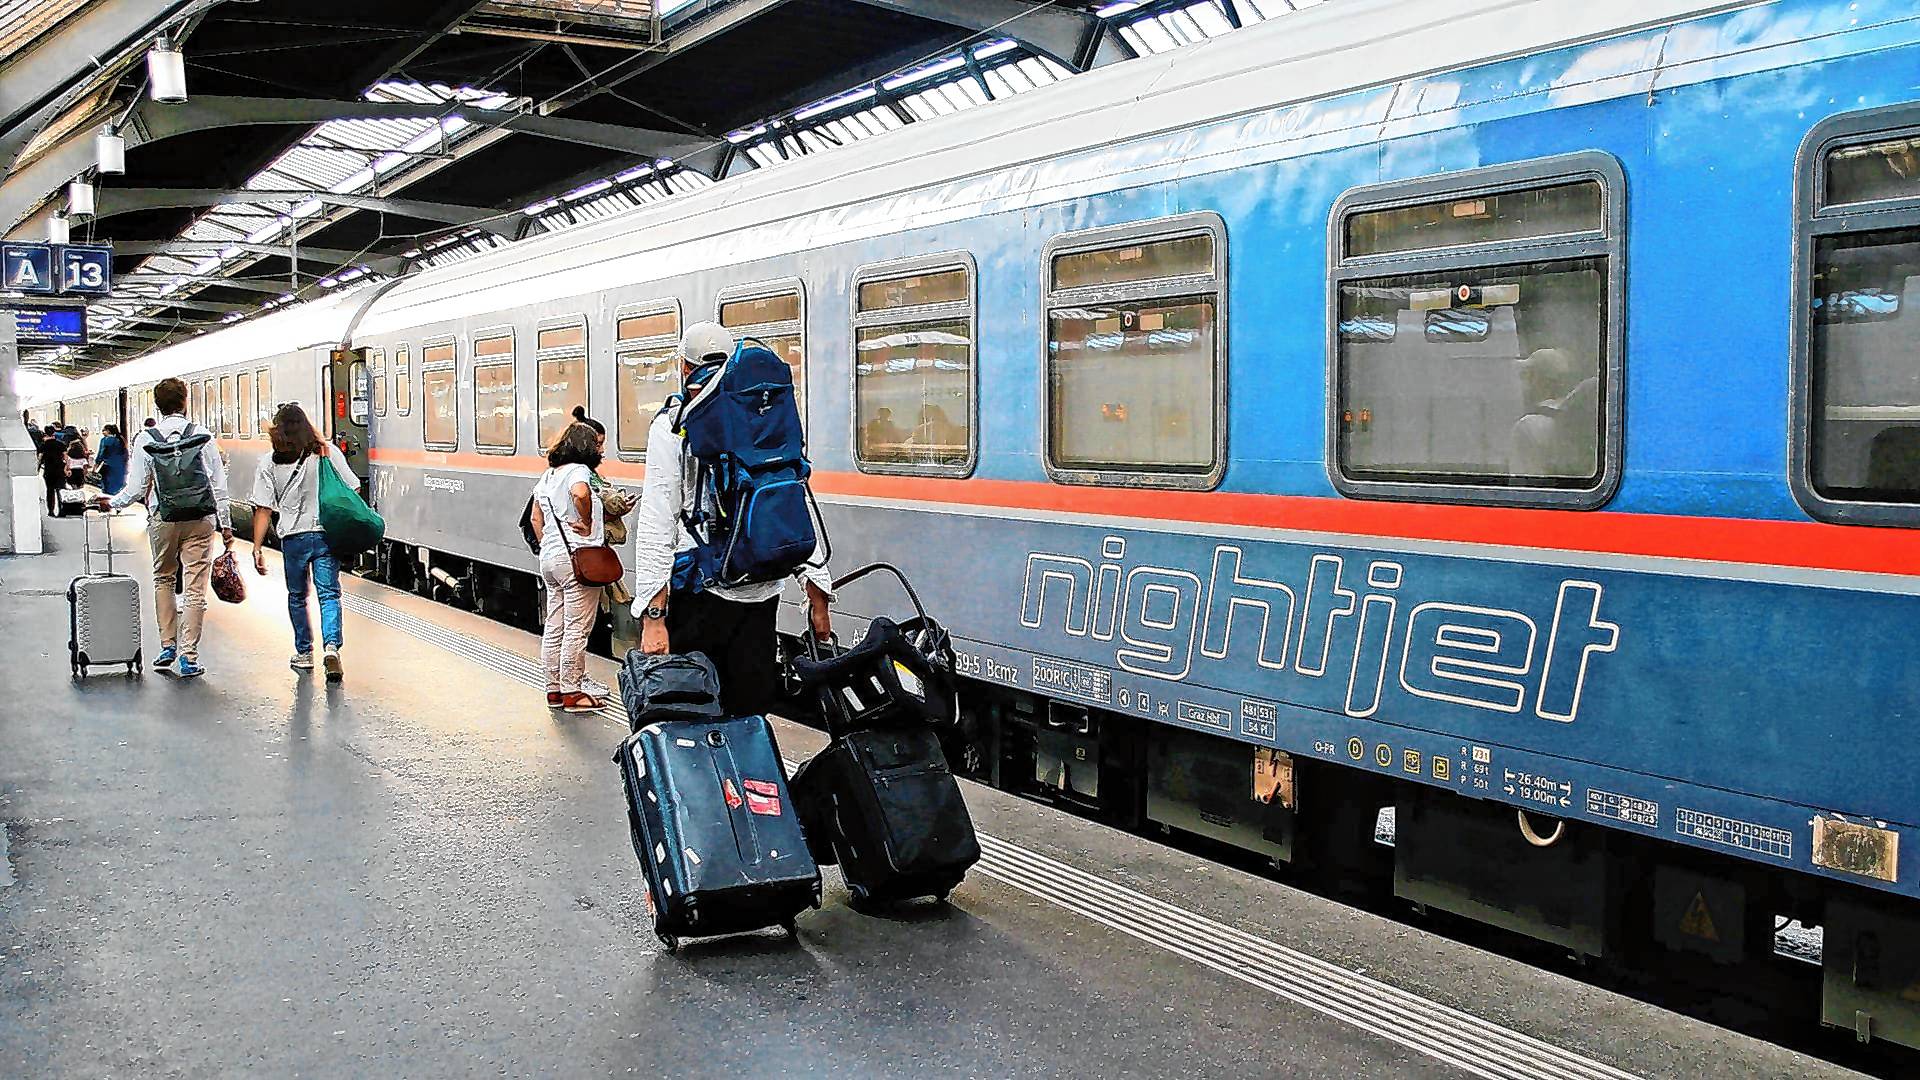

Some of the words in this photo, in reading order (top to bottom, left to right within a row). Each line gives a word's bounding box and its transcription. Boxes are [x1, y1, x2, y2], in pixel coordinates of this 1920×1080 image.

[15, 259, 40, 285] A
[68, 261, 103, 287] 13
[1020, 536, 1621, 722] nightjet
[986, 658, 1018, 683] Bcmz
[1188, 708, 1205, 721] Graz
[1517, 772, 1557, 791] 26.40m
[1519, 786, 1557, 805] 19.00m
[1762, 829, 1771, 839] 10
